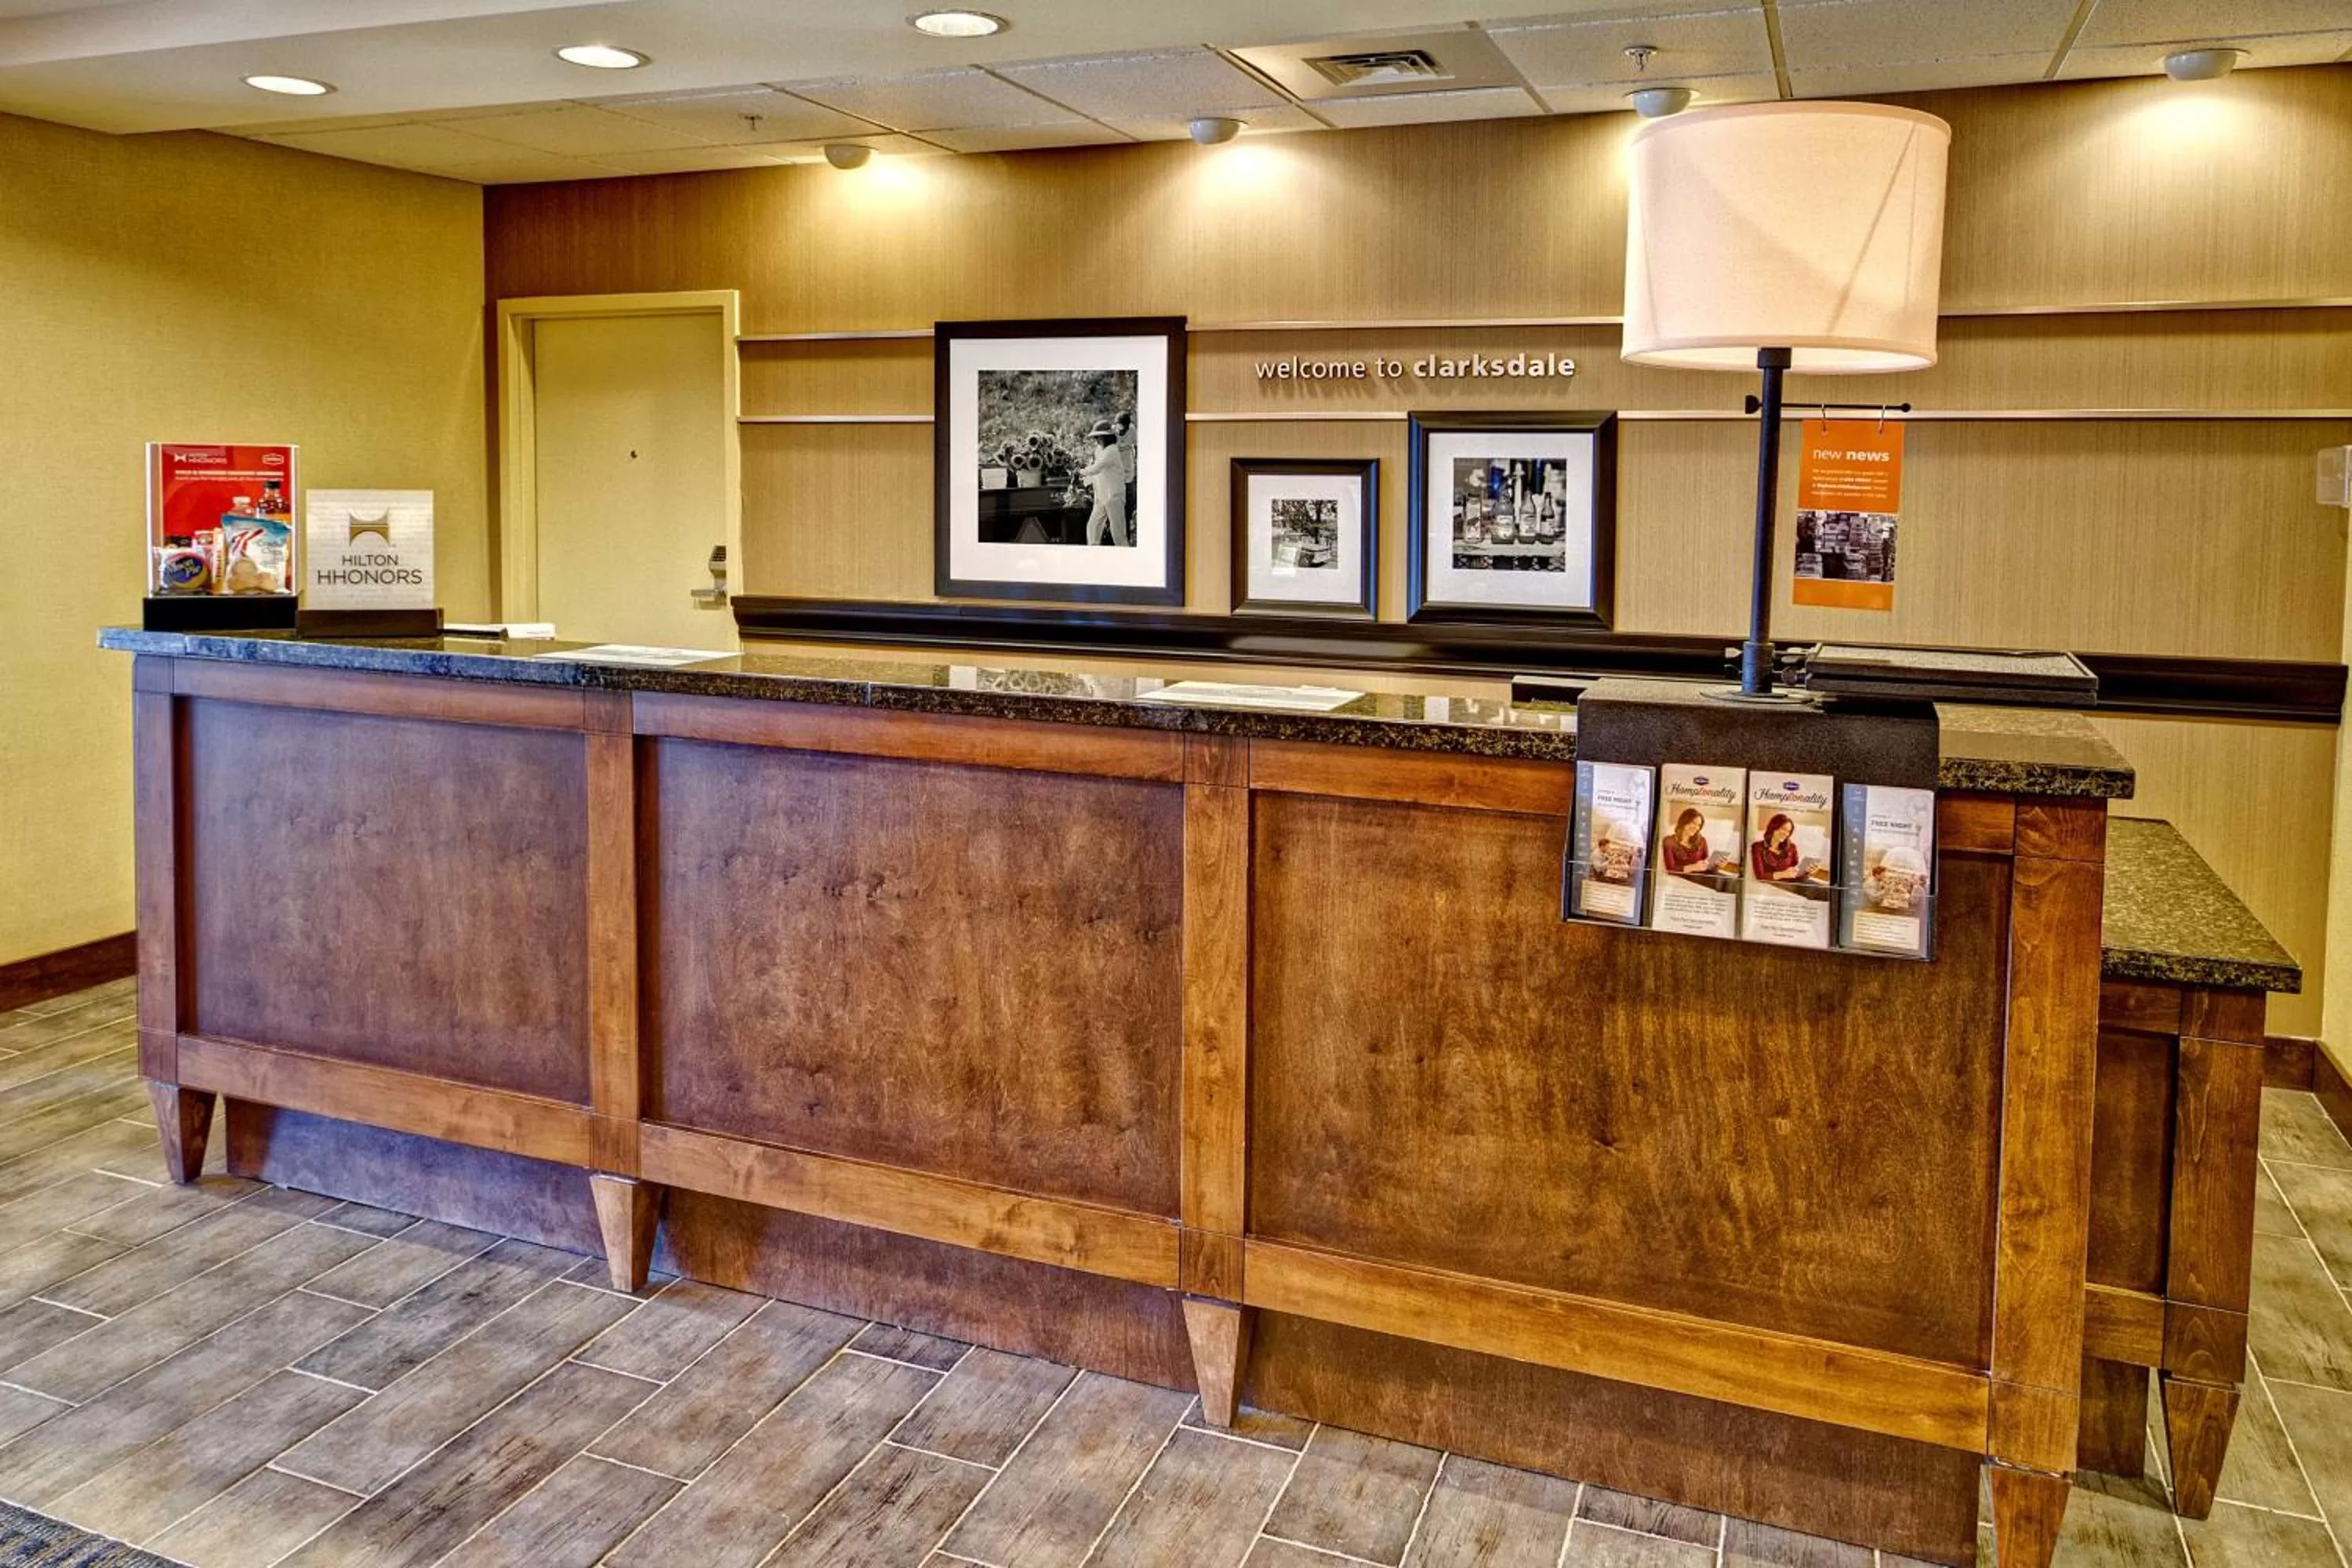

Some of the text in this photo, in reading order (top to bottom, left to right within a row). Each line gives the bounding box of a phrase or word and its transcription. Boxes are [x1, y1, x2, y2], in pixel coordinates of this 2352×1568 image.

[1255, 353, 1576, 379] welcome to clarksdale
[1813, 449, 1890, 462] new news
[342, 554, 399, 566] HILTON
[318, 569, 423, 584] HHONORS
[1665, 782, 1737, 804] Hamptonality
[1754, 787, 1828, 809] Hamptonality
